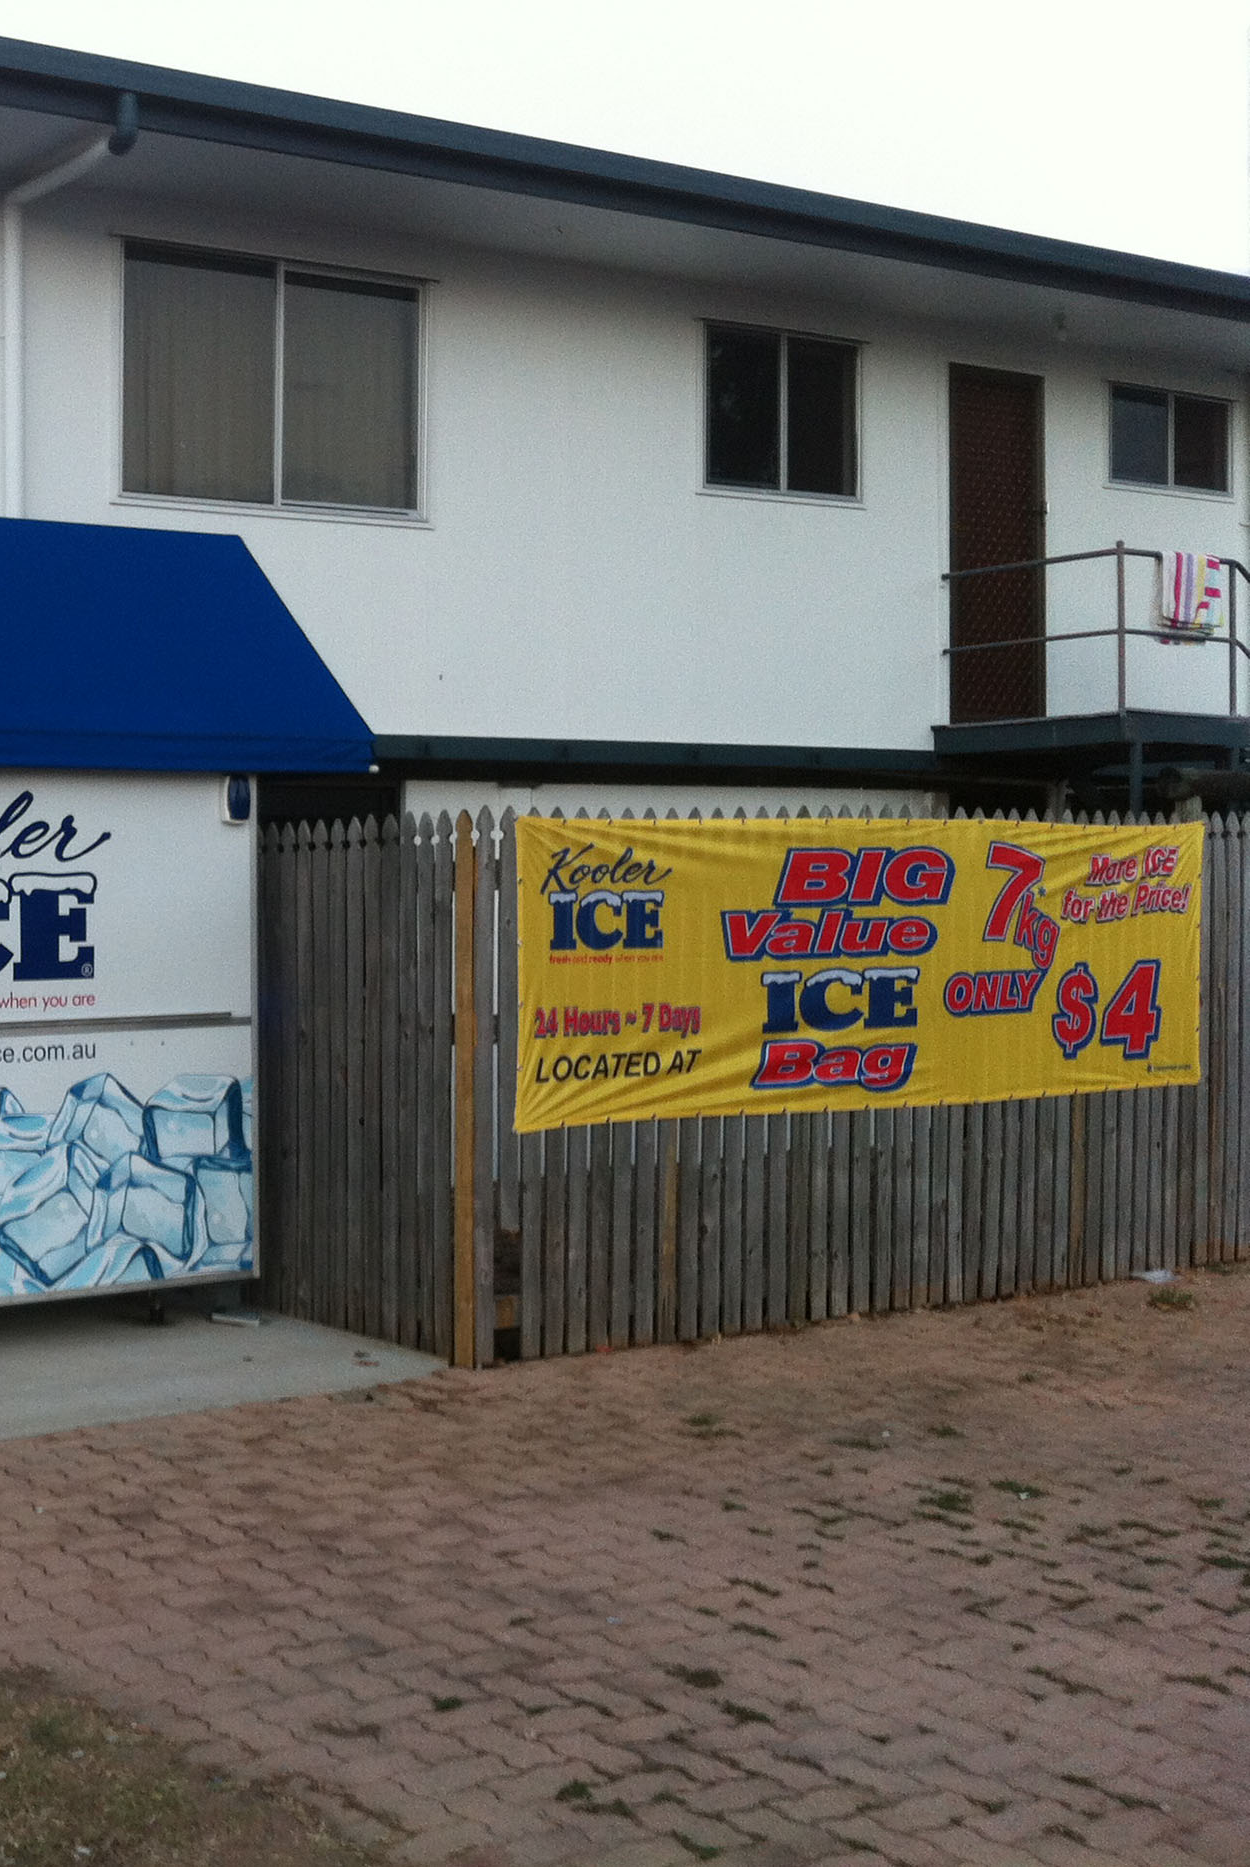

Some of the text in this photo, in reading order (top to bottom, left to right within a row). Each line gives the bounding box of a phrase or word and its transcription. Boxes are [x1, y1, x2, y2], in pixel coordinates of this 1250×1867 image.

[540, 842, 672, 895] Kooler
[772, 846, 956, 908] BIG
[1084, 846, 1180, 887] More ICE
[548, 889, 665, 951] ICE
[1060, 888, 1094, 923] for
[721, 909, 939, 961] Value
[42, 993, 68, 1012] you
[72, 992, 96, 1006] are
[760, 968, 920, 1034] ICE
[943, 969, 1049, 1017] ONLY
[1052, 959, 1162, 1061] $4
[534, 1005, 558, 1038] 24
[563, 1004, 622, 1037] Hours
[641, 1002, 654, 1033] 7
[658, 1002, 700, 1038] Days
[535, 1049, 702, 1083] LOCATED AT
[749, 1040, 918, 1093] Bag
